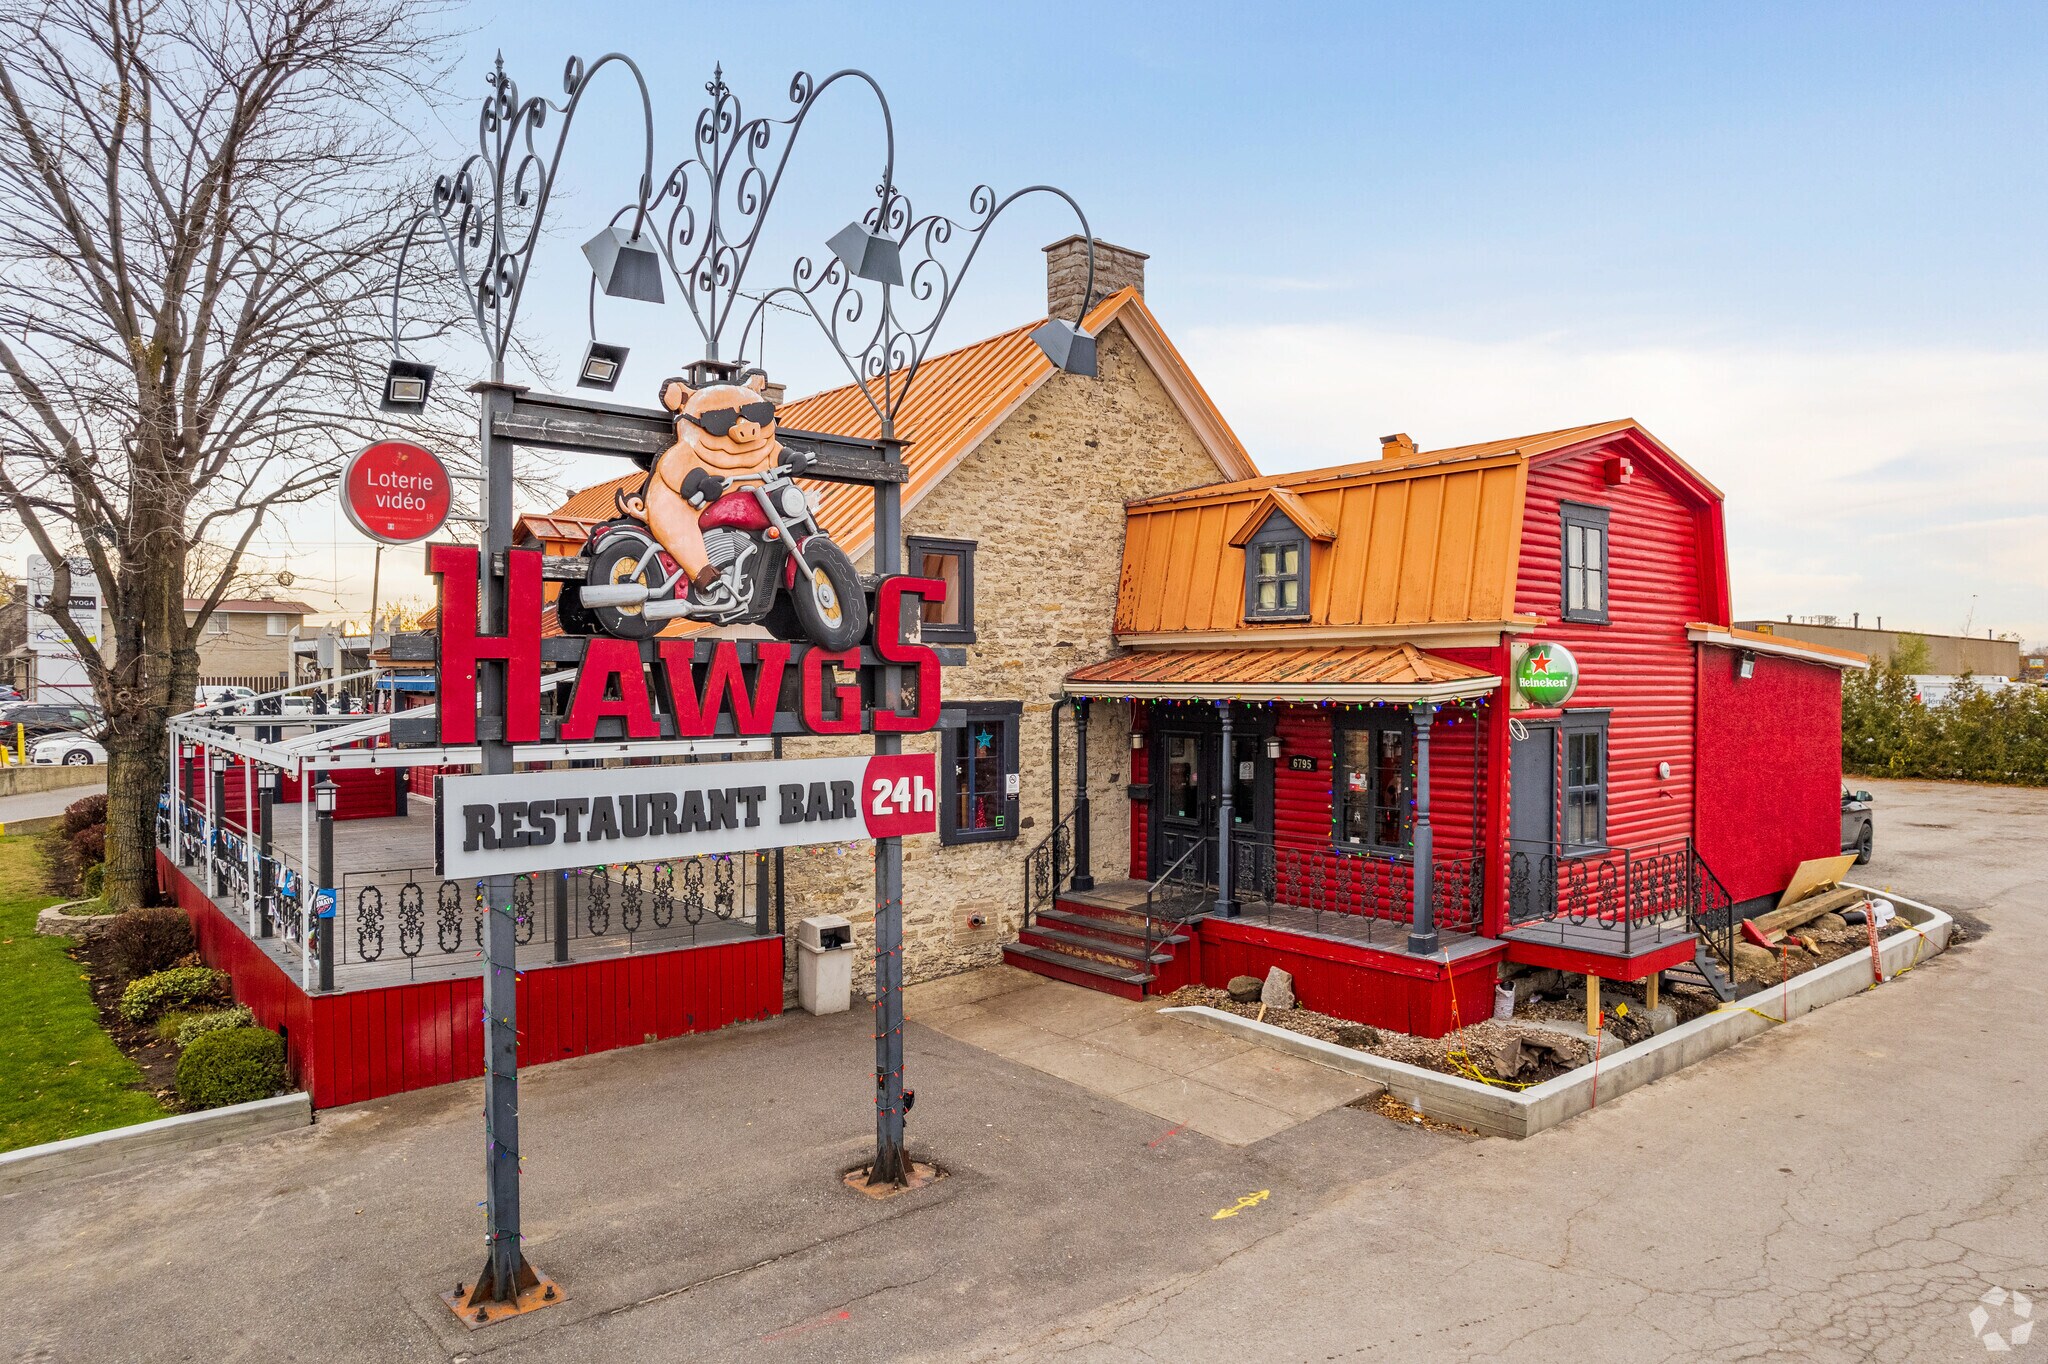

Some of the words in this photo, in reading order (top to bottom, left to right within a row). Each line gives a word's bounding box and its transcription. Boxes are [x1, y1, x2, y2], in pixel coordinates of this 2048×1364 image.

[367, 468, 433, 490] Loterie
[376, 491, 426, 511] vidéo
[427, 543, 947, 745] HAWGS
[1519, 677, 1568, 687] Heineken
[1293, 758, 1312, 769] 6795
[463, 785, 766, 852] RESTAURANT
[779, 780, 857, 824] BAR
[871, 775, 934, 817] 24h
